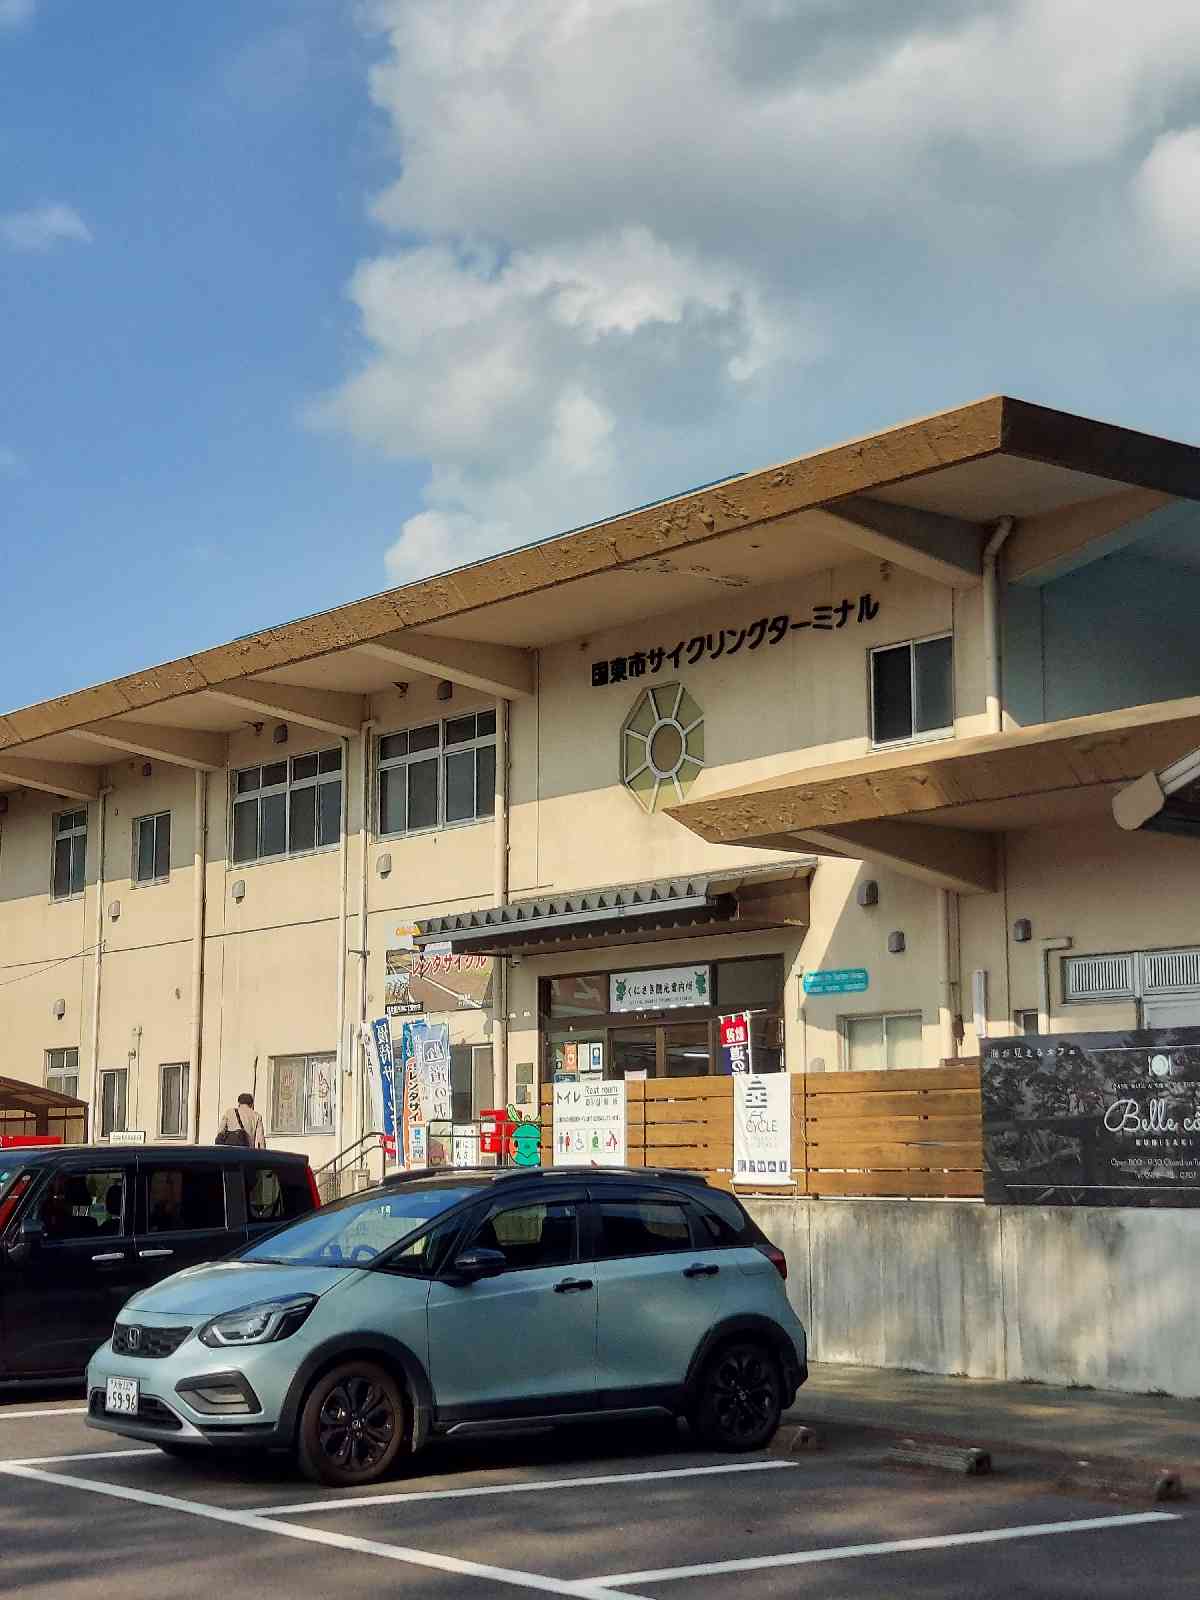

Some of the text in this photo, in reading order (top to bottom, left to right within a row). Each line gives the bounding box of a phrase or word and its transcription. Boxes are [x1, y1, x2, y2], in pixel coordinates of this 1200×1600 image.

[591, 594, 880, 686] 国東市サイクリングターミナル
[412, 953, 489, 976] レンタサイクル
[556, 1089, 581, 1105] トイレ
[1104, 1098, 1177, 1132] Belle
[745, 1119, 778, 1134] CYCLE
[1135, 1138, 1193, 1146] KUNISAKI
